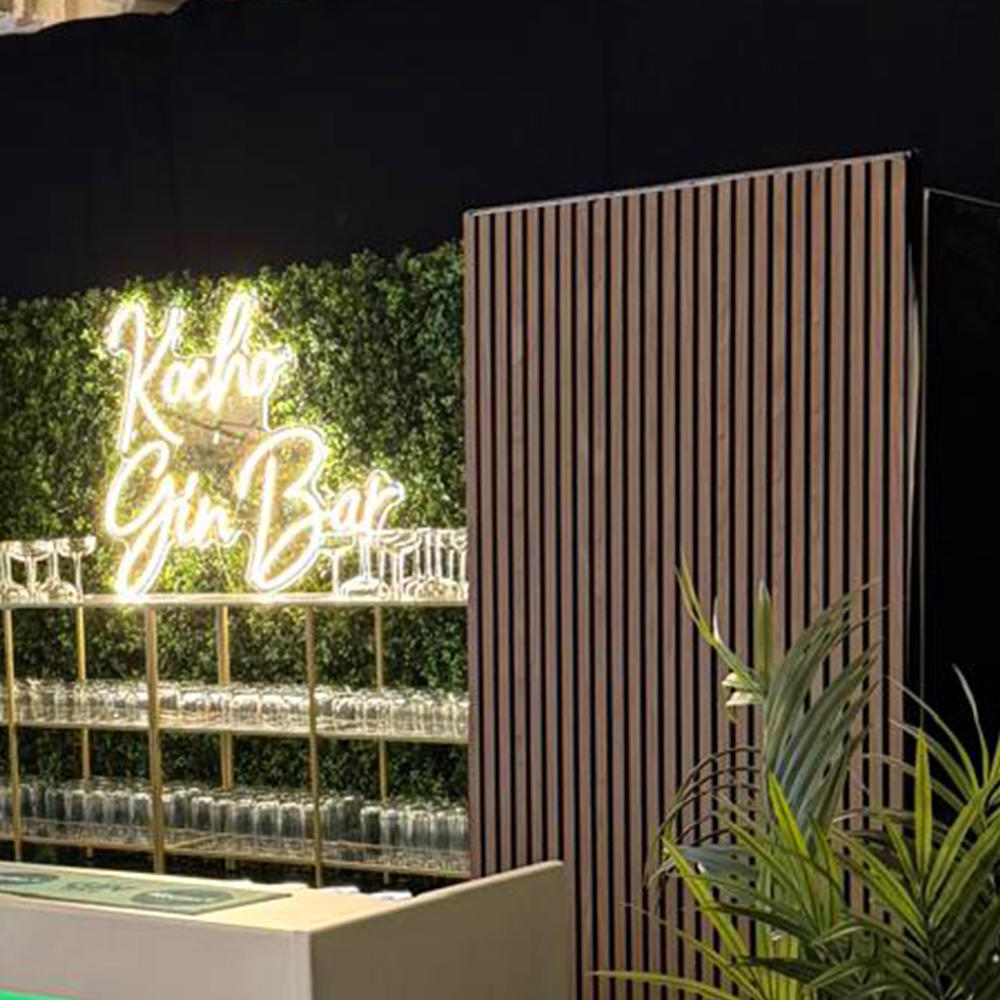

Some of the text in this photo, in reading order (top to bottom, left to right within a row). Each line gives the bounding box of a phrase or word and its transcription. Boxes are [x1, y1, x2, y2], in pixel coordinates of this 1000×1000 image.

[105, 290, 294, 452] Kocho
[104, 426, 403, 600] Gin Bar
